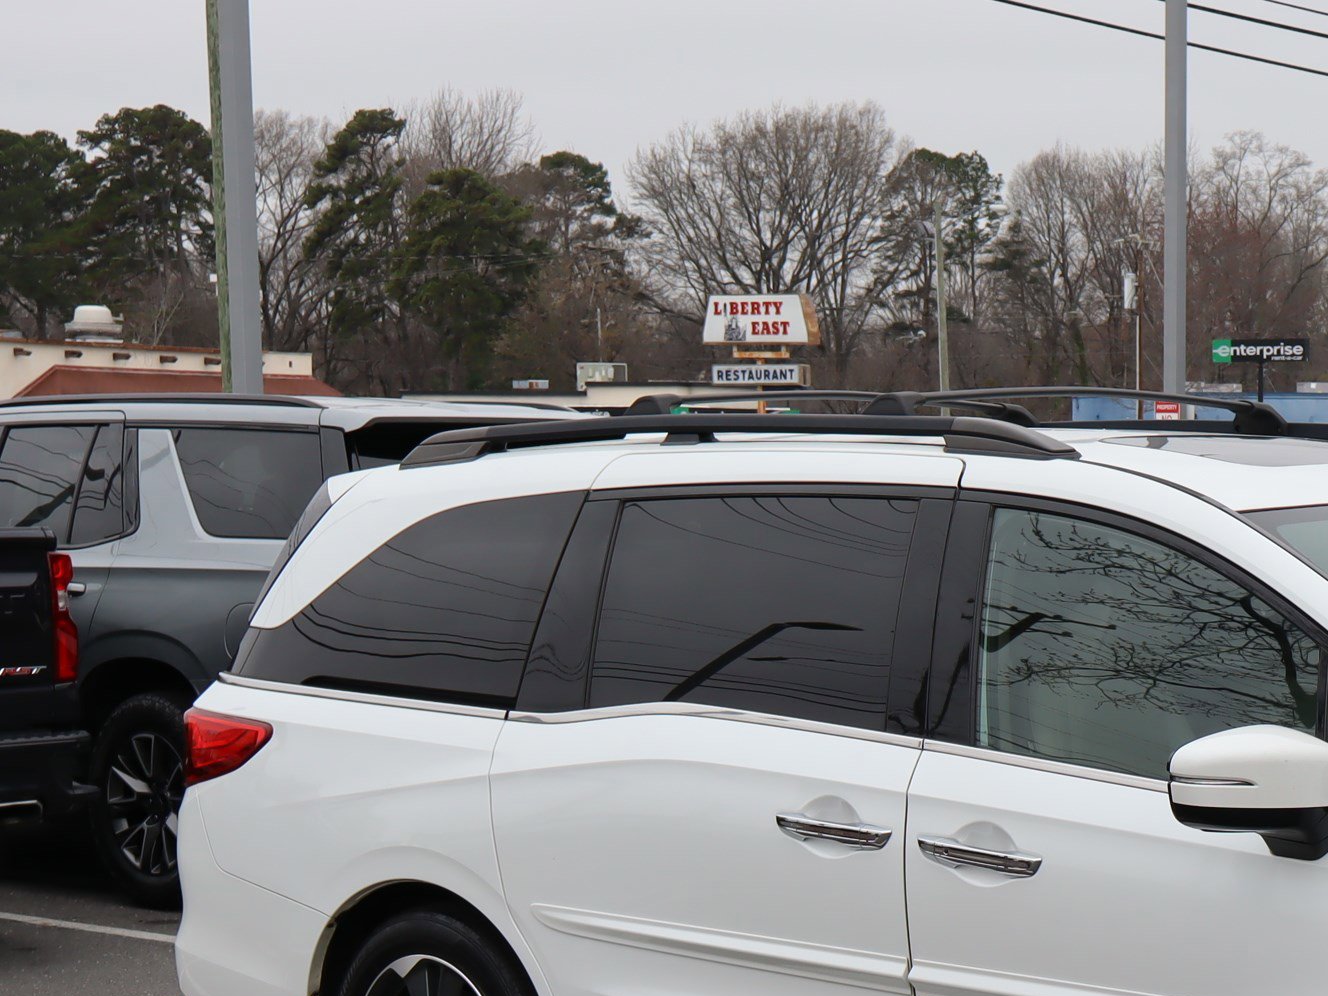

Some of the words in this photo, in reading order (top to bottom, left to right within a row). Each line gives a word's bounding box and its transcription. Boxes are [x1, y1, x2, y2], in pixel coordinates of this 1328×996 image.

[713, 301, 783, 316] LIBERTY
[751, 321, 790, 335] EAST
[1216, 342, 1304, 359] enterprise
[717, 368, 795, 381] RESTAURANT
